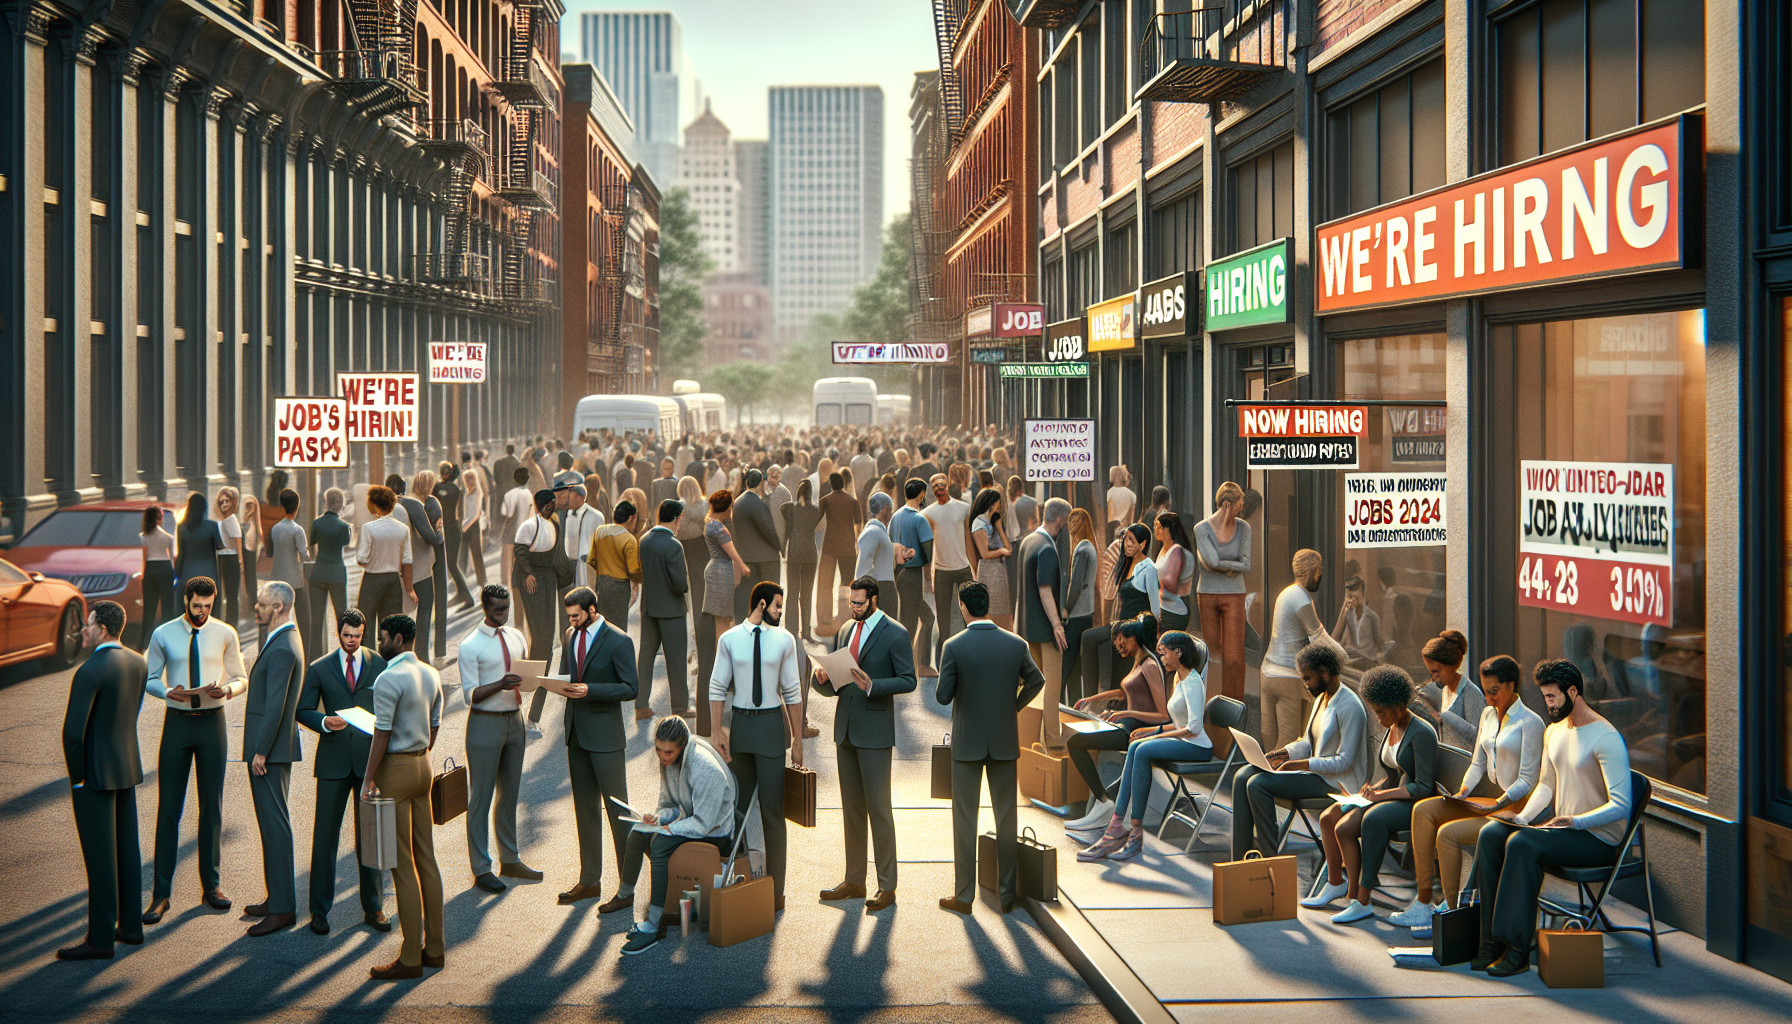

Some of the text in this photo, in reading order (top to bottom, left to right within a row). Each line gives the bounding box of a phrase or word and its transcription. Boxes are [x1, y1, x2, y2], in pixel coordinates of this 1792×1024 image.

[1321, 143, 1669, 298] WE'RE HIRNG
[1210, 254, 1286, 317] HIRING
[1002, 311, 1042, 330] JOB
[279, 403, 339, 431] JOB'S
[1244, 409, 1290, 434] NOW
[1295, 409, 1362, 434] HIRING
[1349, 499, 1393, 526] JOBS
[1524, 499, 1557, 537] JOB
